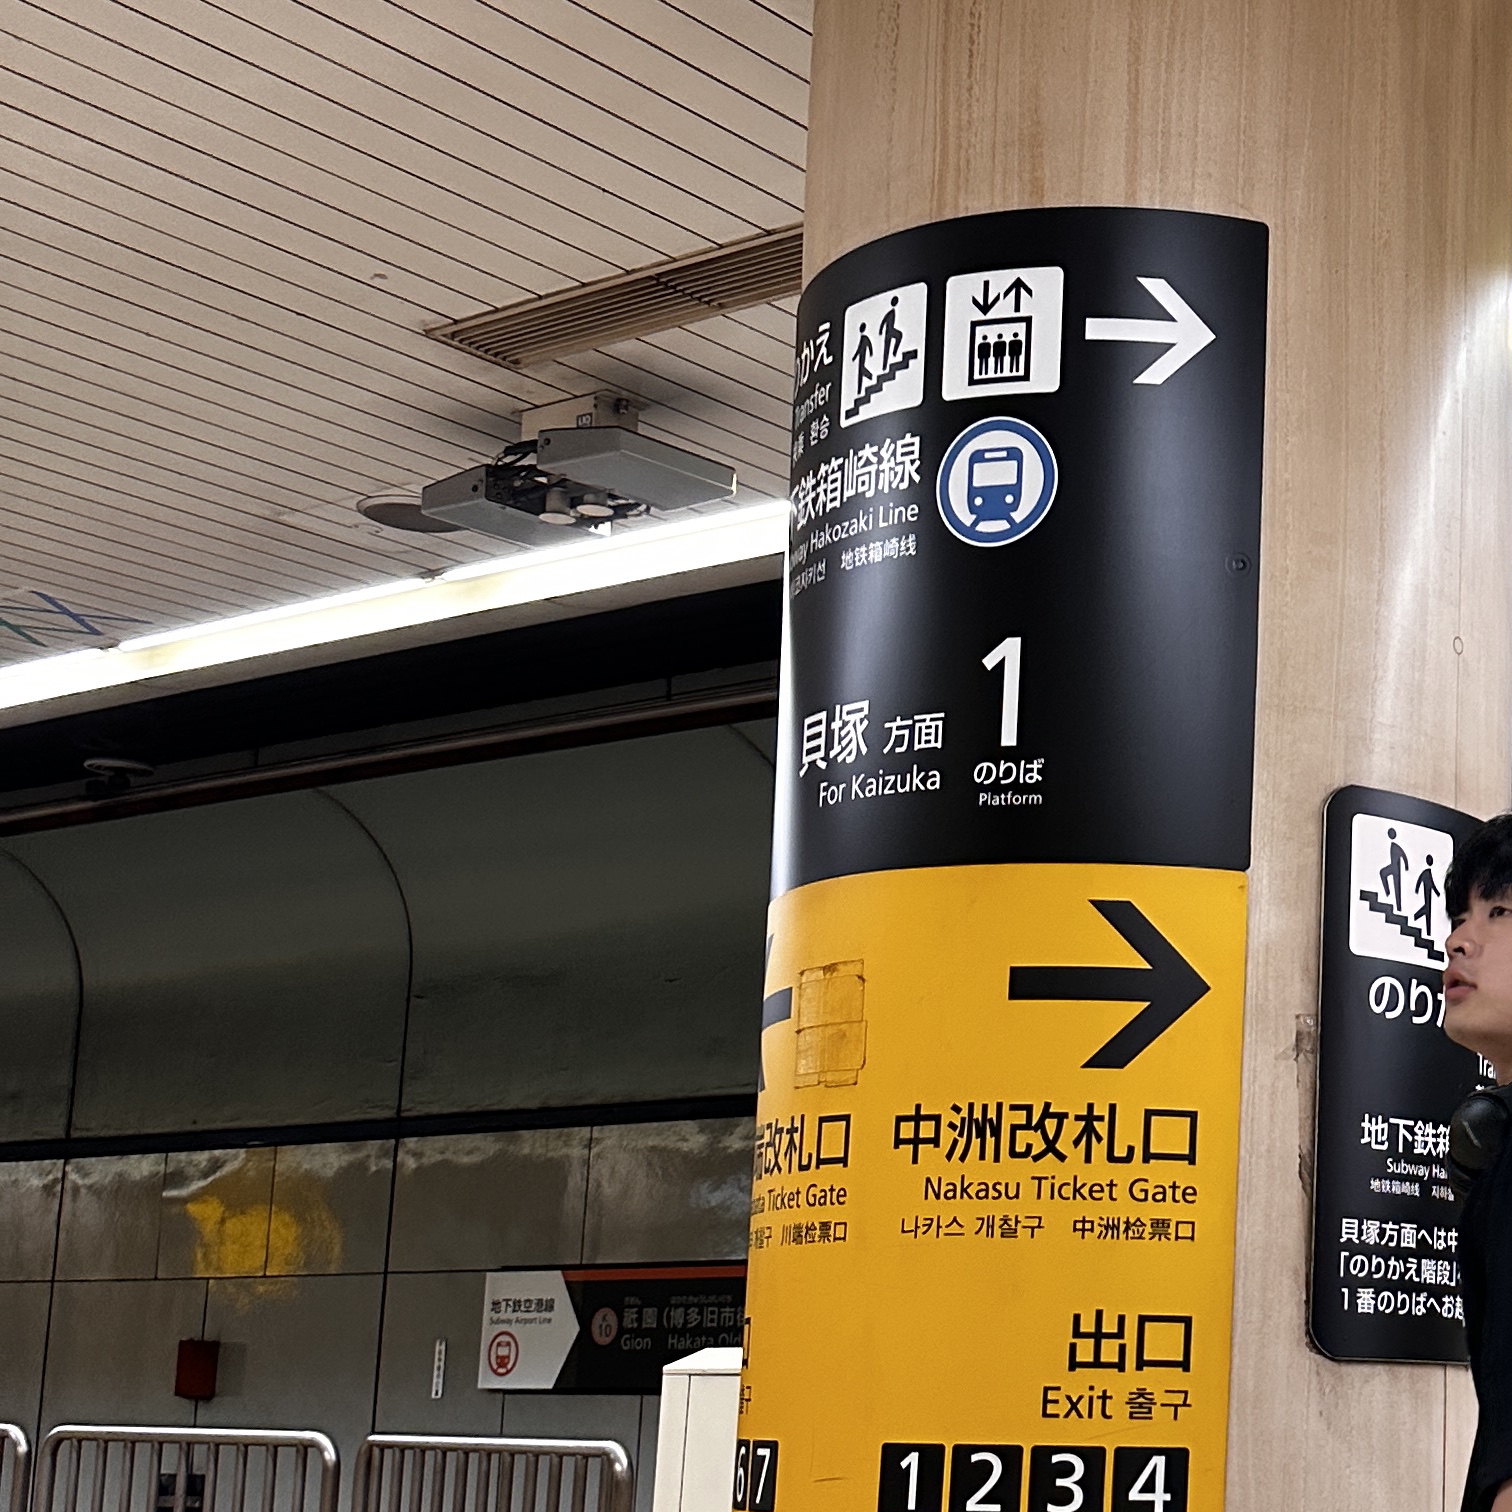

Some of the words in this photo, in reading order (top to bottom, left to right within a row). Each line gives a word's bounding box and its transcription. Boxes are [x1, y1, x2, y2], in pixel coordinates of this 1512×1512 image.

[809, 507, 873, 554] Hakozaki
[879, 502, 919, 528] Line
[982, 637, 1021, 746] 1
[799, 700, 869, 777] 貝塚
[883, 712, 945, 754] 方面
[819, 782, 845, 807] For
[851, 763, 941, 800] Kaizuka
[974, 759, 1044, 784] のりば
[979, 791, 1042, 806] Platform
[893, 1101, 1199, 1167] 中洲改札口
[1387, 1158, 1429, 1180] Subway
[767, 1187, 801, 1212] Ticket
[806, 1184, 847, 1207] Gate
[924, 1174, 1020, 1201] Nakasu
[1031, 1175, 1118, 1202] Ticket
[1128, 1178, 1198, 1204] Gate
[901, 1216, 966, 1239] 나카스
[975, 1215, 1044, 1239] 개찰구
[1072, 1216, 1196, 1242] 中洲检票口
[1339, 1252, 1463, 1287] 「のりかえ階段」
[621, 1333, 651, 1350] Gion
[667, 1333, 714, 1350] Hakata
[1068, 1309, 1193, 1372] 出口
[1041, 1386, 1113, 1419] Exit
[1125, 1387, 1193, 1421] 출구
[736, 1446, 746, 1503] 6
[755, 1447, 771, 1504] 7
[900, 1451, 919, 1511] 1
[966, 1452, 1002, 1512] 2
